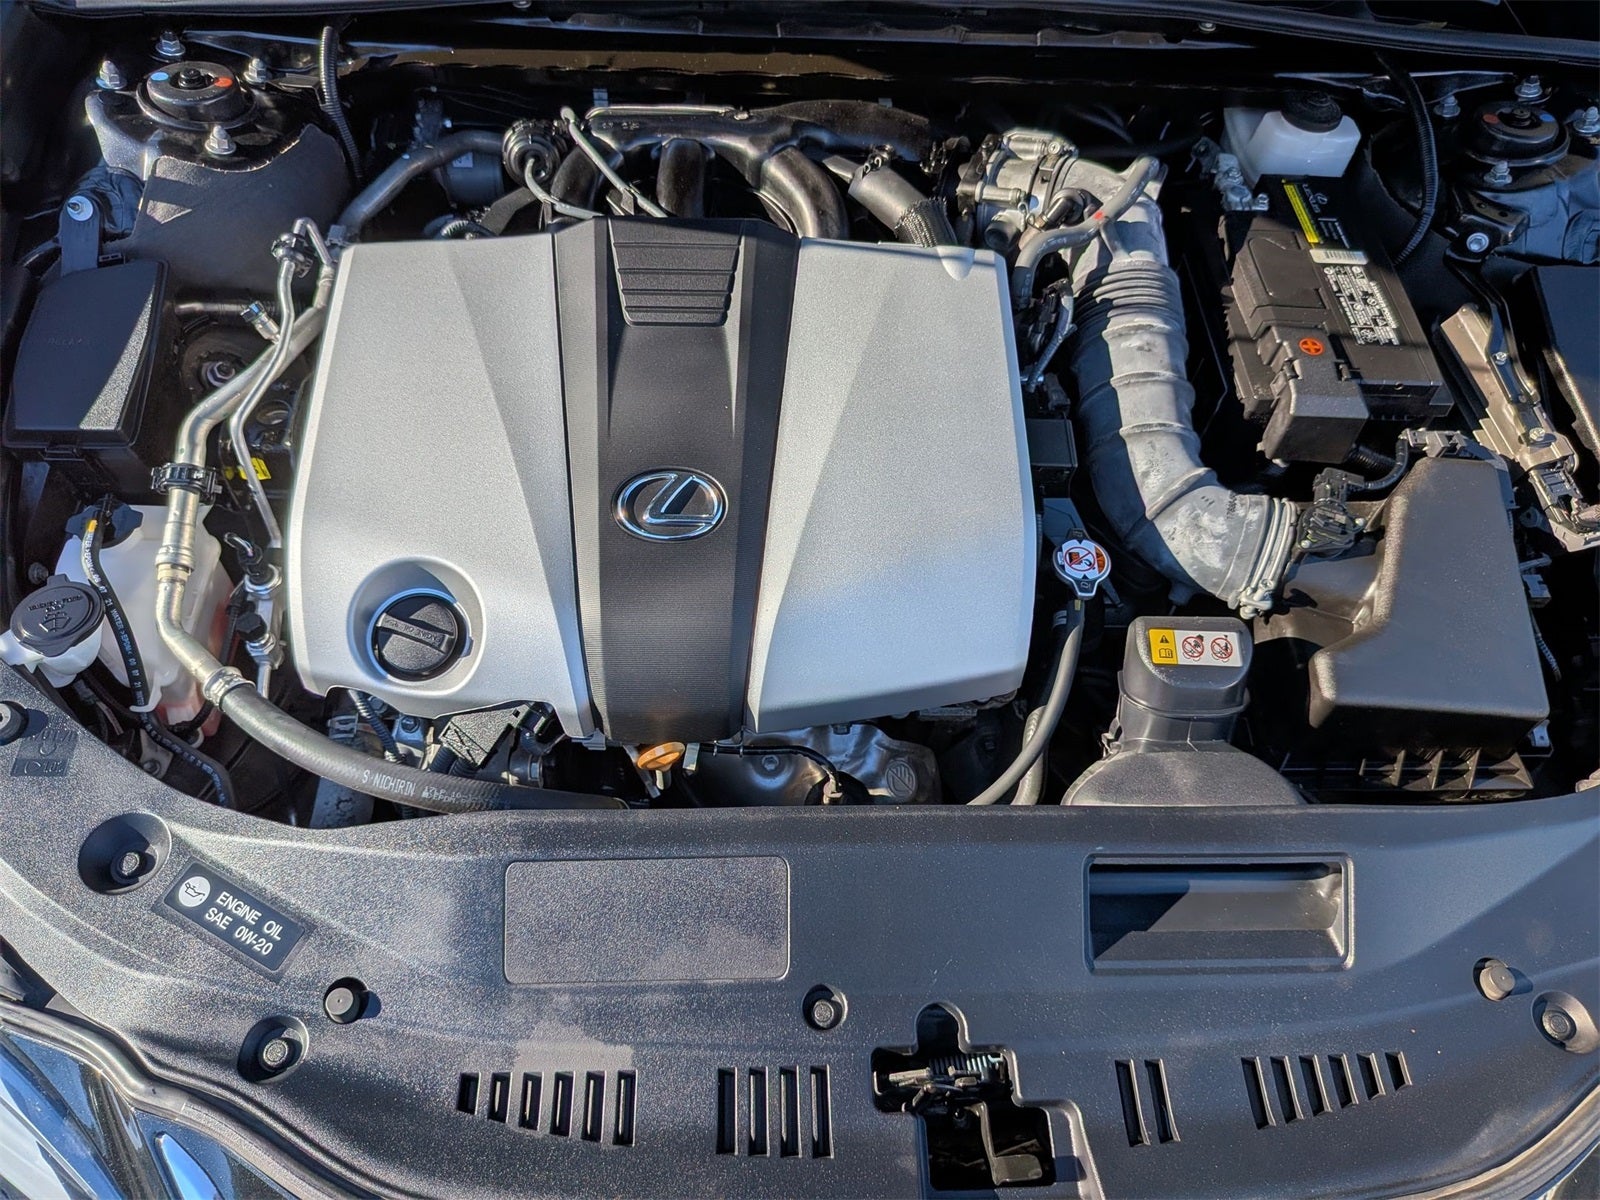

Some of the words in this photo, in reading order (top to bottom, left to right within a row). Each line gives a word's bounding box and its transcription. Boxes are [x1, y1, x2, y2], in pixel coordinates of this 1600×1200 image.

[205, 907, 233, 930] SAE
[235, 925, 273, 956] 0W-20
[216, 891, 262, 925] ENGINE
[263, 920, 283, 940] OIL
